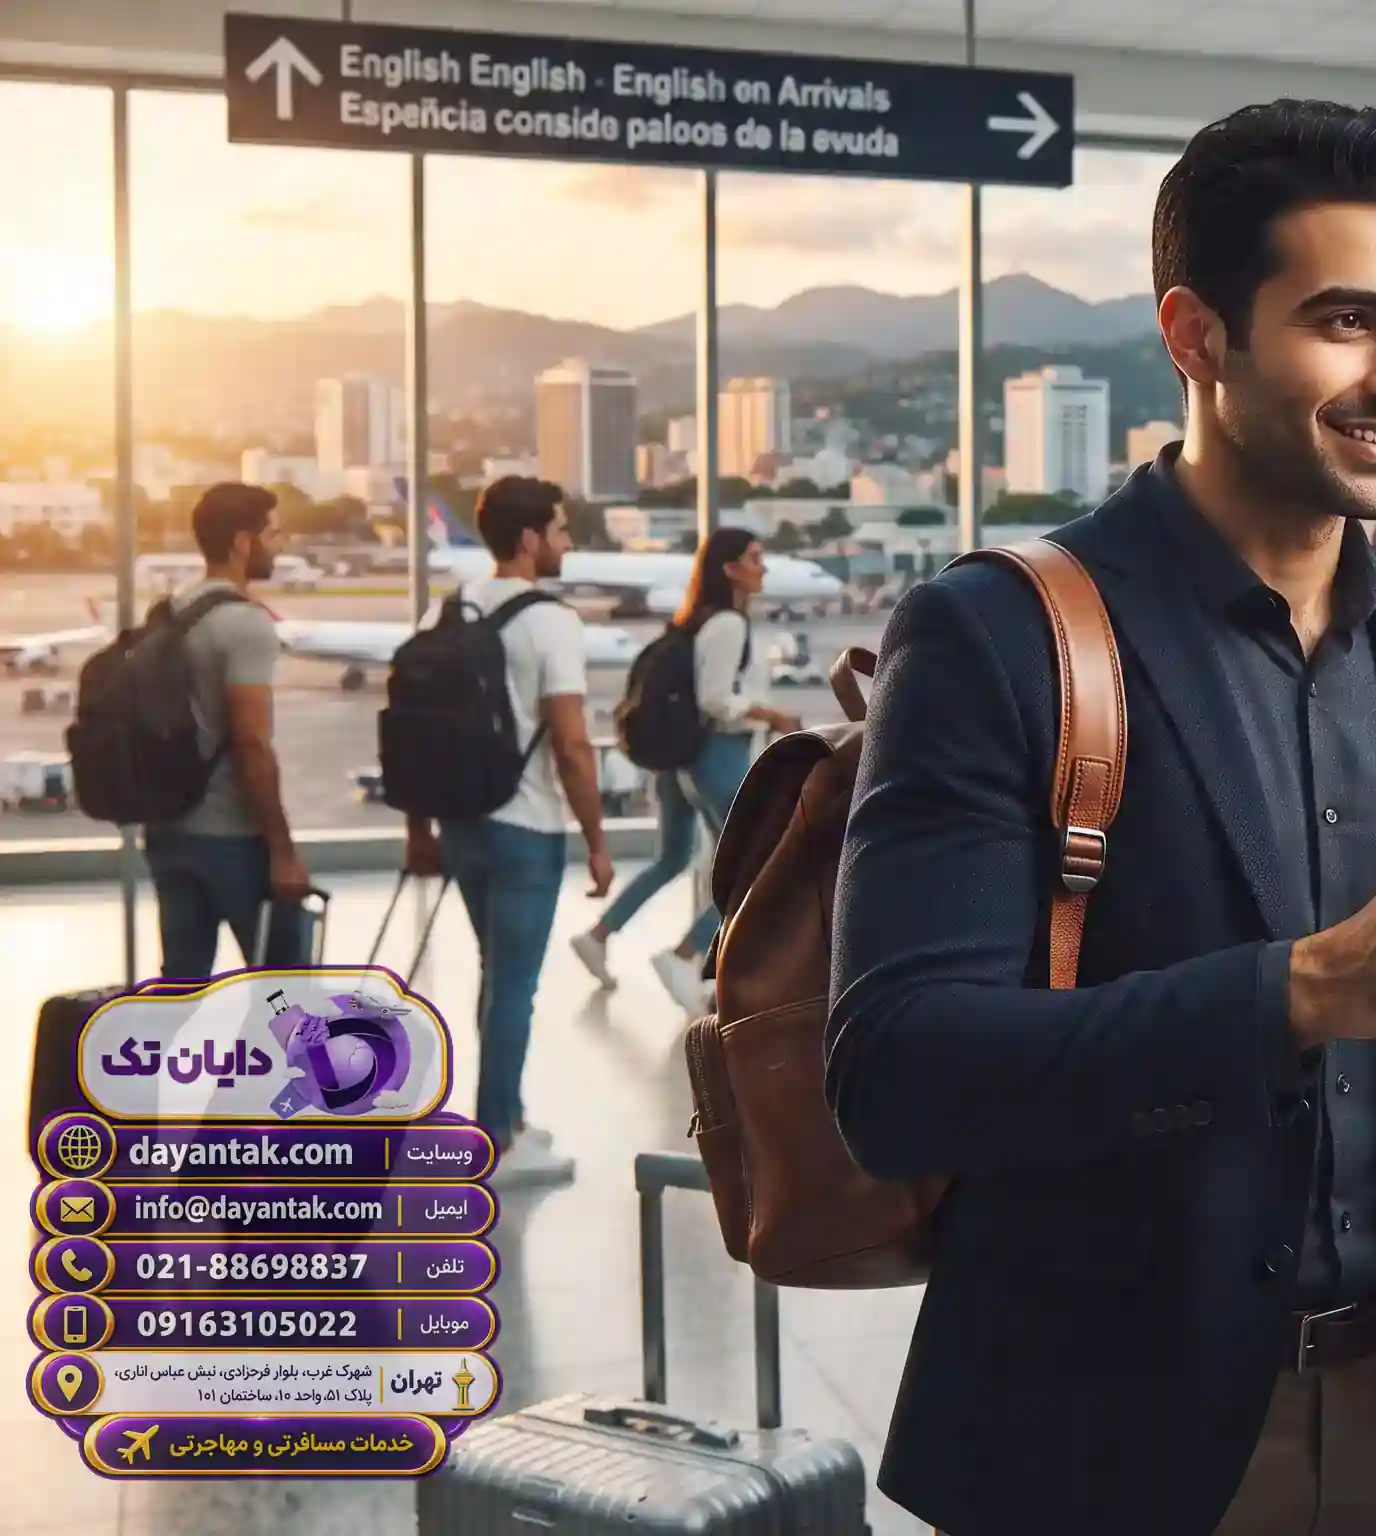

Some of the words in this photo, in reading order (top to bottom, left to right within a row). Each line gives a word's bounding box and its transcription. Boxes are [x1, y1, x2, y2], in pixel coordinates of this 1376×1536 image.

[340, 45, 460, 87] English
[470, 53, 585, 96] English
[614, 63, 726, 105] English
[733, 79, 770, 105] on
[779, 75, 890, 112] Arrivals
[781, 119, 805, 152] la
